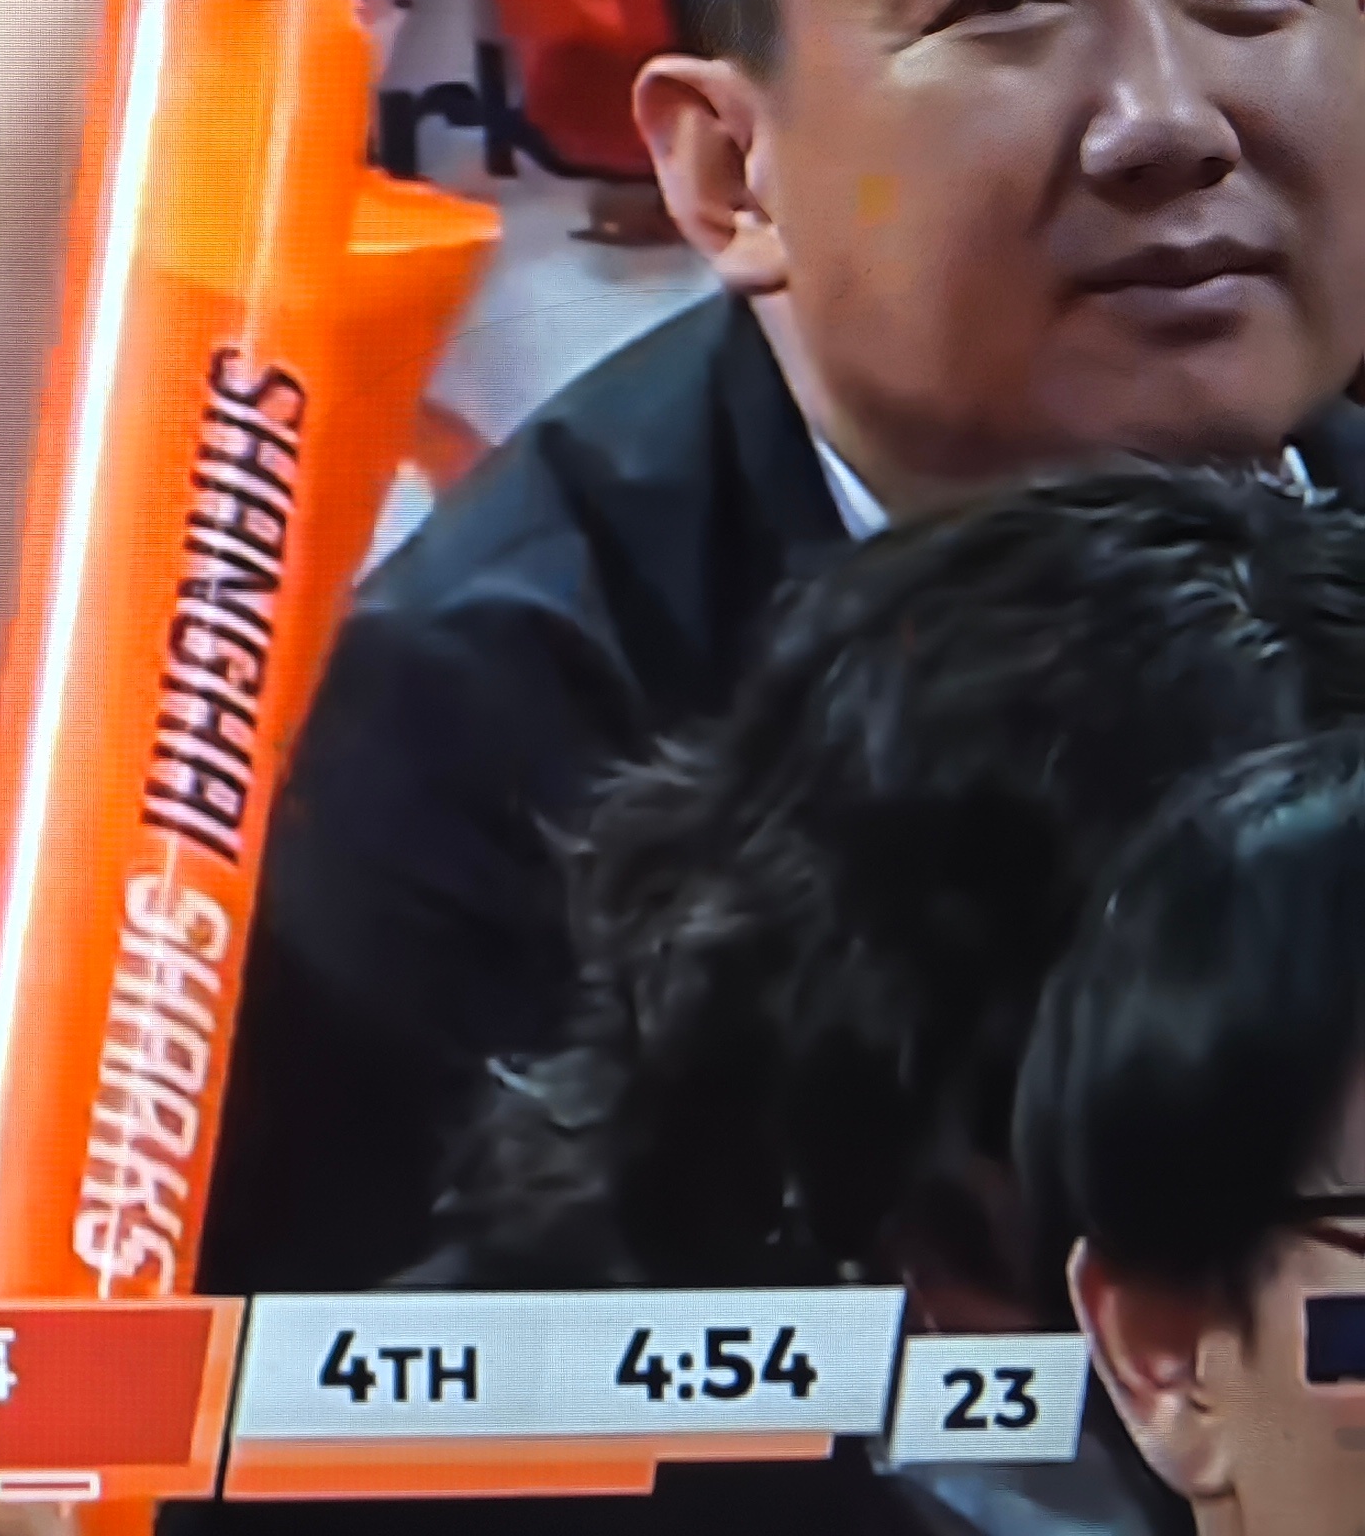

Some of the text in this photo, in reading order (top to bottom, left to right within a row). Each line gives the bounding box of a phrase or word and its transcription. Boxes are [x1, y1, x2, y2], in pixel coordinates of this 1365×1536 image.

[73, 346, 307, 1298] SHANGHAI SHARKS
[319, 1329, 478, 1404] 4TH
[614, 1325, 818, 1402] 4:54
[942, 1366, 1040, 1432] 23
